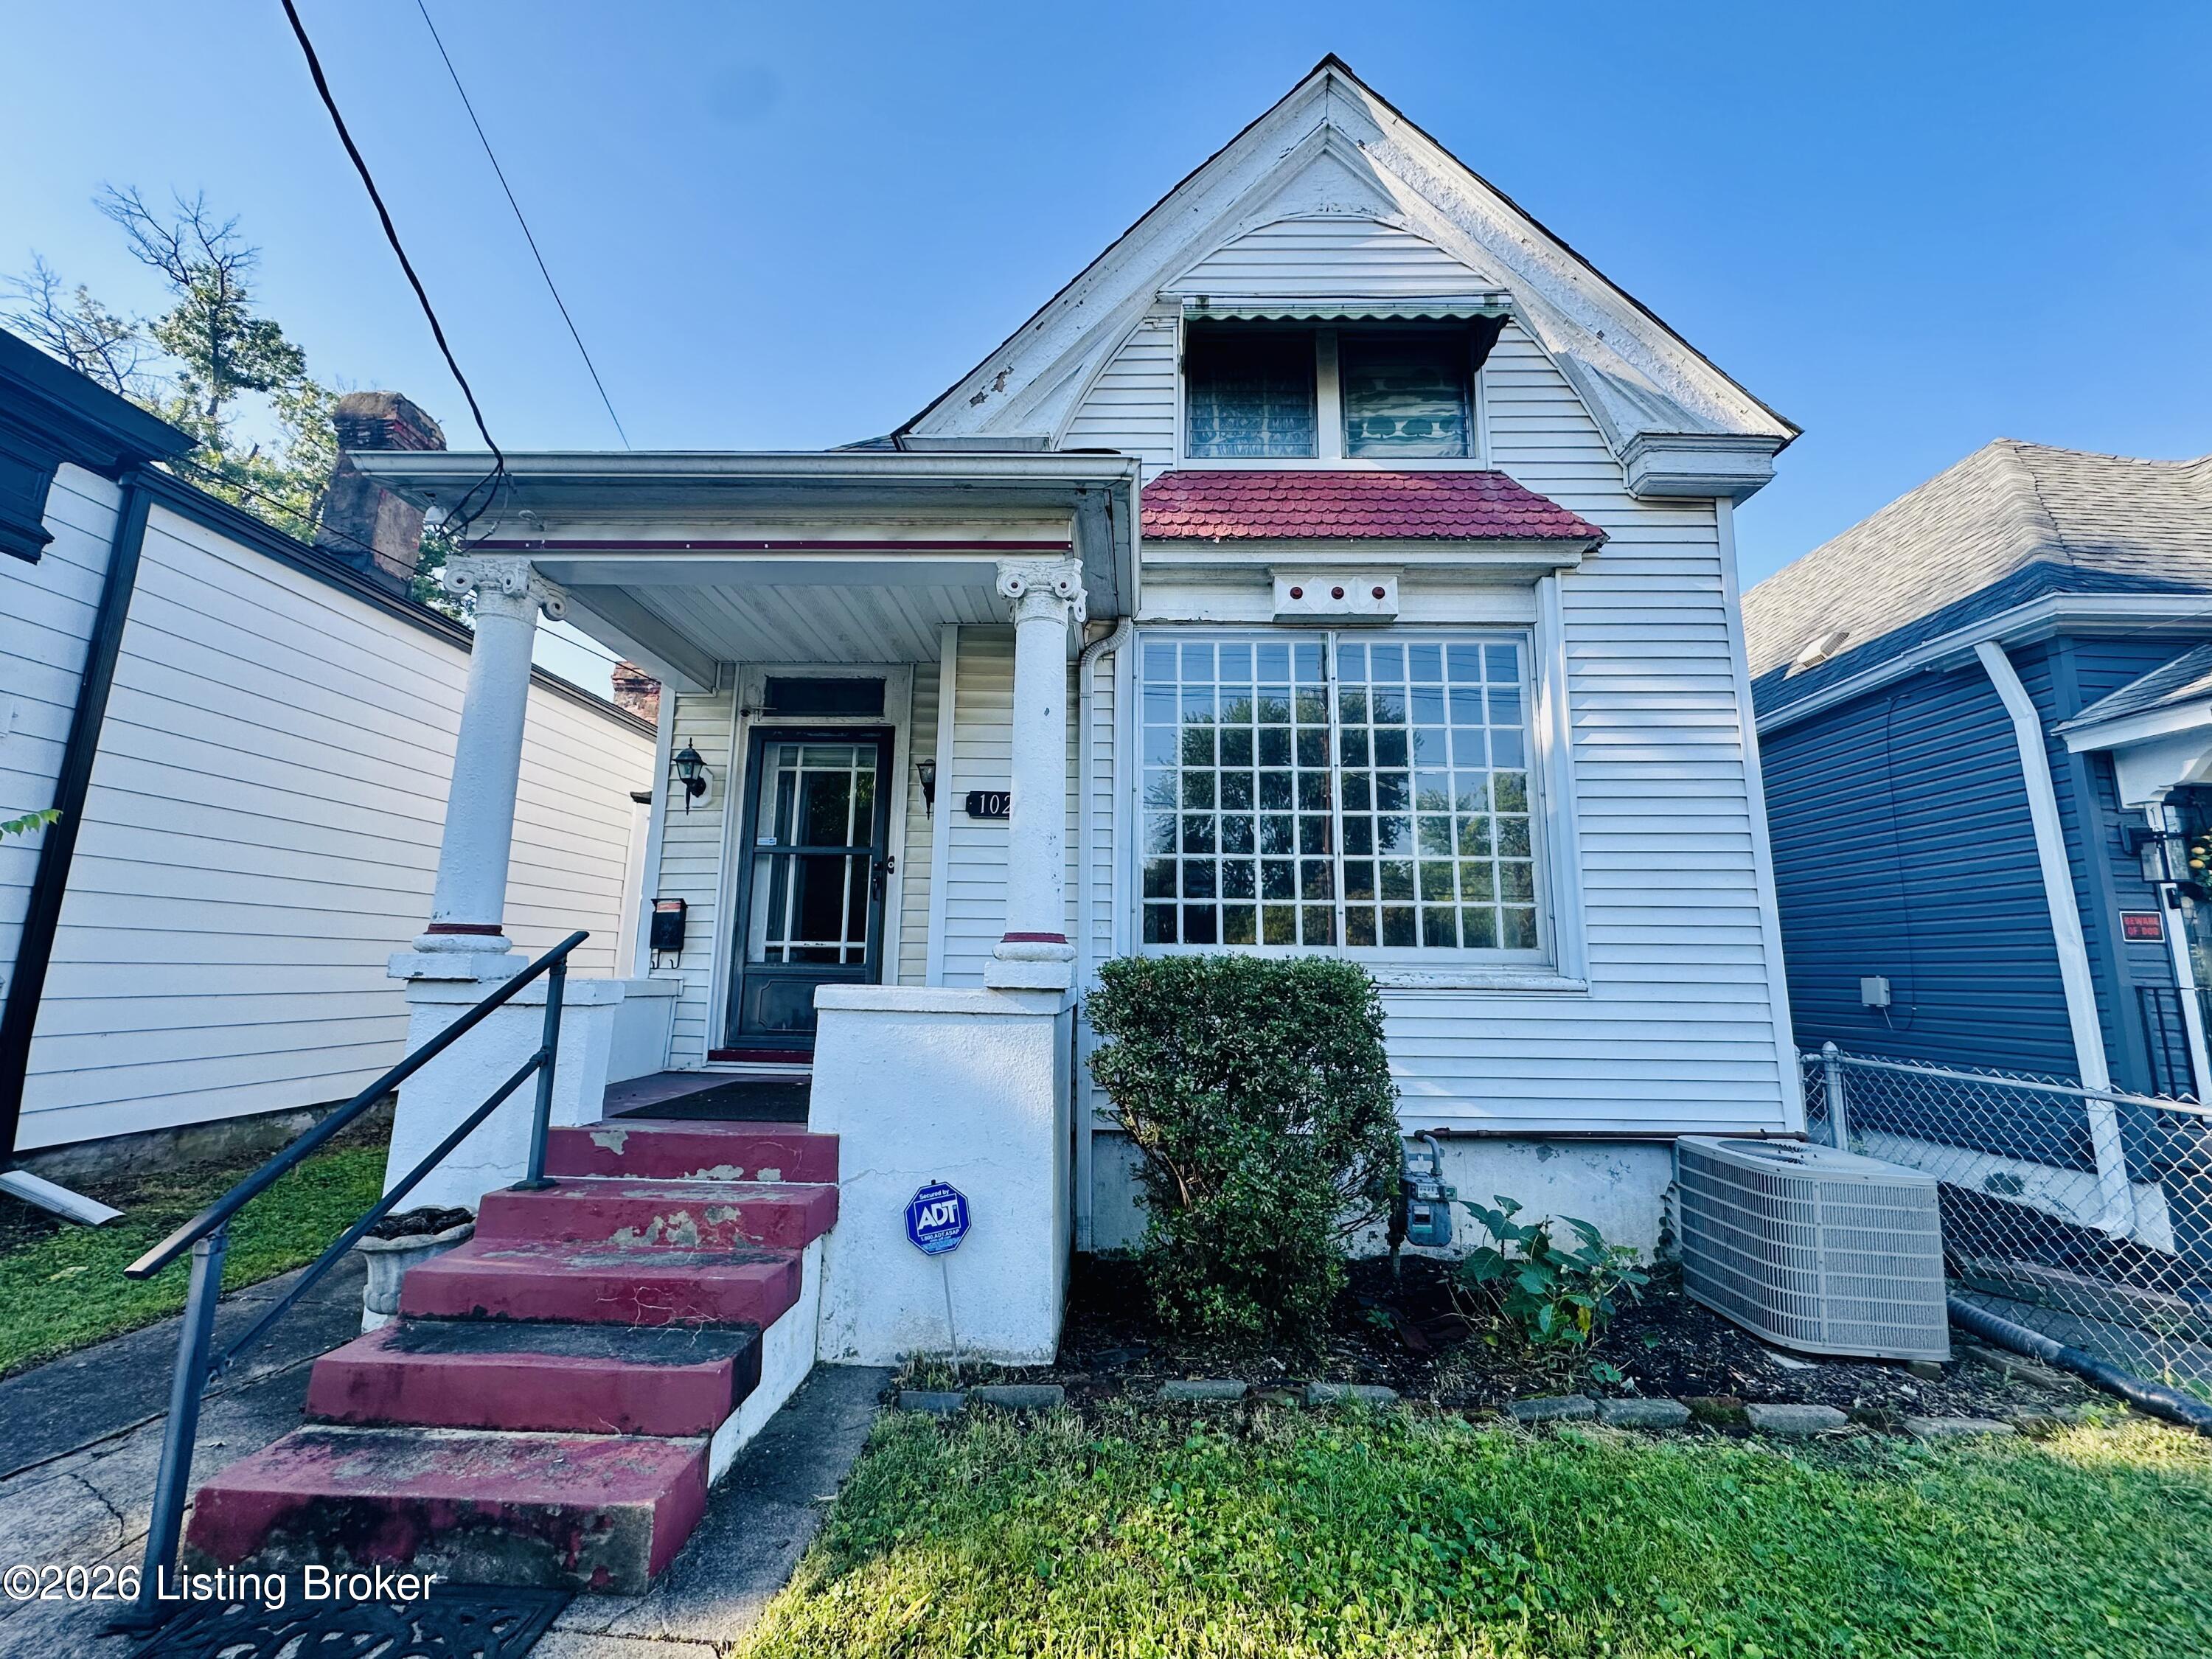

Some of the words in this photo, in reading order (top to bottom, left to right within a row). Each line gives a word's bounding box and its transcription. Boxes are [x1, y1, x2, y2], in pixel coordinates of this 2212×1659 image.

[2124, 917, 2159, 926] BEWARE
[2127, 927, 2138, 936] OF
[2141, 927, 2159, 936] DOG
[919, 1189, 942, 1200] Secured
[918, 1200, 958, 1230] ADT
